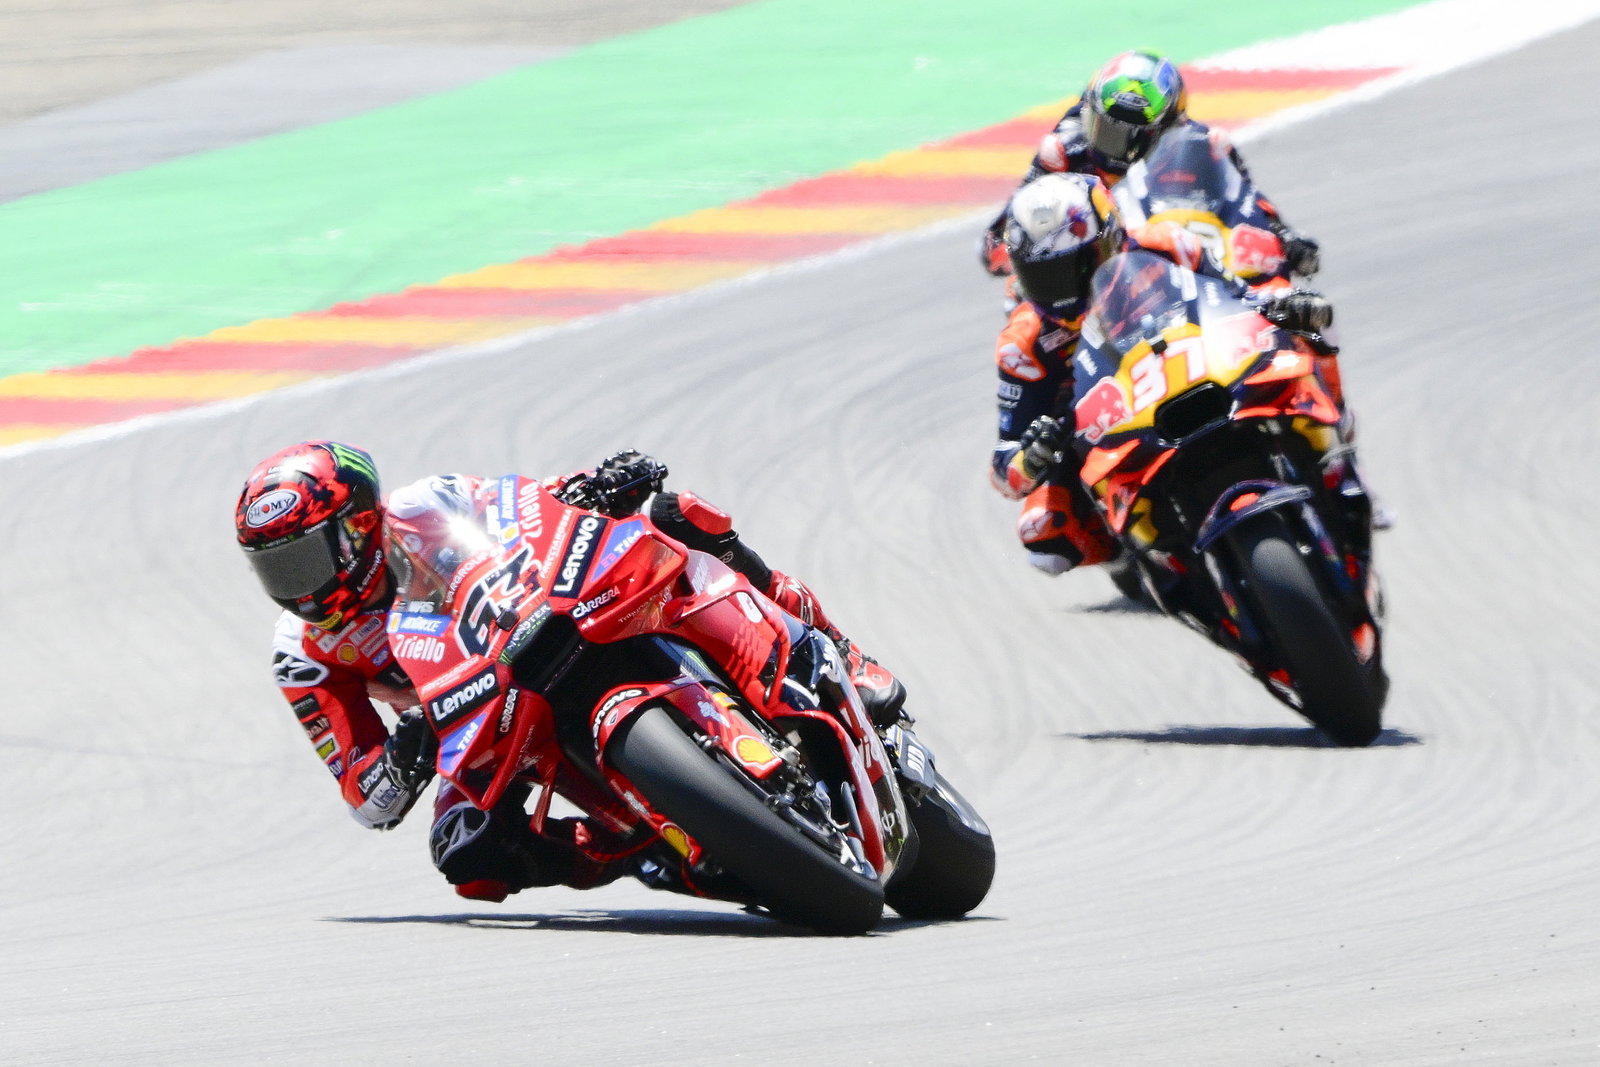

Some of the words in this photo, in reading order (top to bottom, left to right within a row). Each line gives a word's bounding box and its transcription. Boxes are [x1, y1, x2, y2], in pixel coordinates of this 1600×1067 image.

[1131, 336, 1207, 415] 37
[553, 517, 599, 592] Lenovo
[613, 530, 642, 553] TIM
[572, 585, 621, 618] CARRERA
[431, 673, 496, 720] Lenovo
[500, 688, 519, 733] CARRERA
[358, 762, 384, 794] Lenovo
